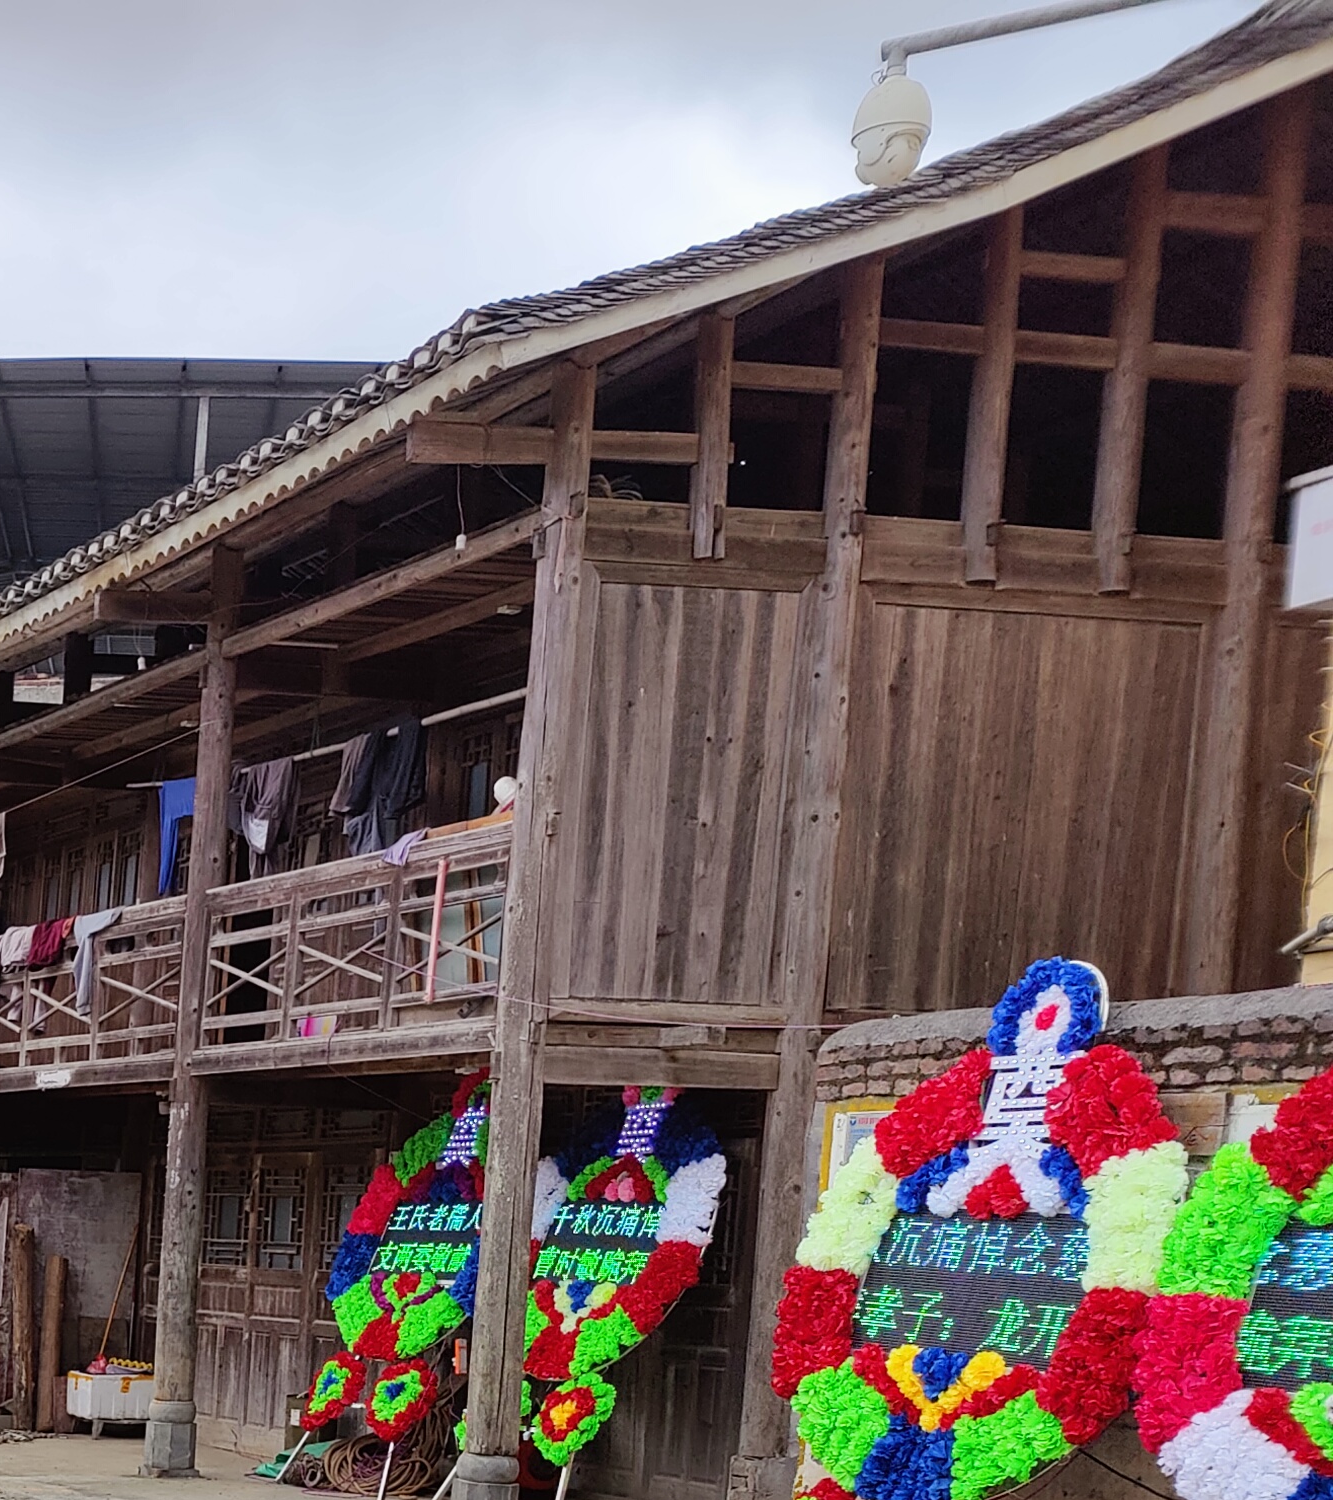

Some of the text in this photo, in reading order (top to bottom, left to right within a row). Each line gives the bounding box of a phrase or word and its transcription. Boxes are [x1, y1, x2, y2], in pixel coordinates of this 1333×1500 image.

[387, 1202, 483, 1232] 王氏老孺人
[873, 1217, 1091, 1283] 沉痛悼念慈
[852, 1284, 1077, 1359] 孝子：龙开
